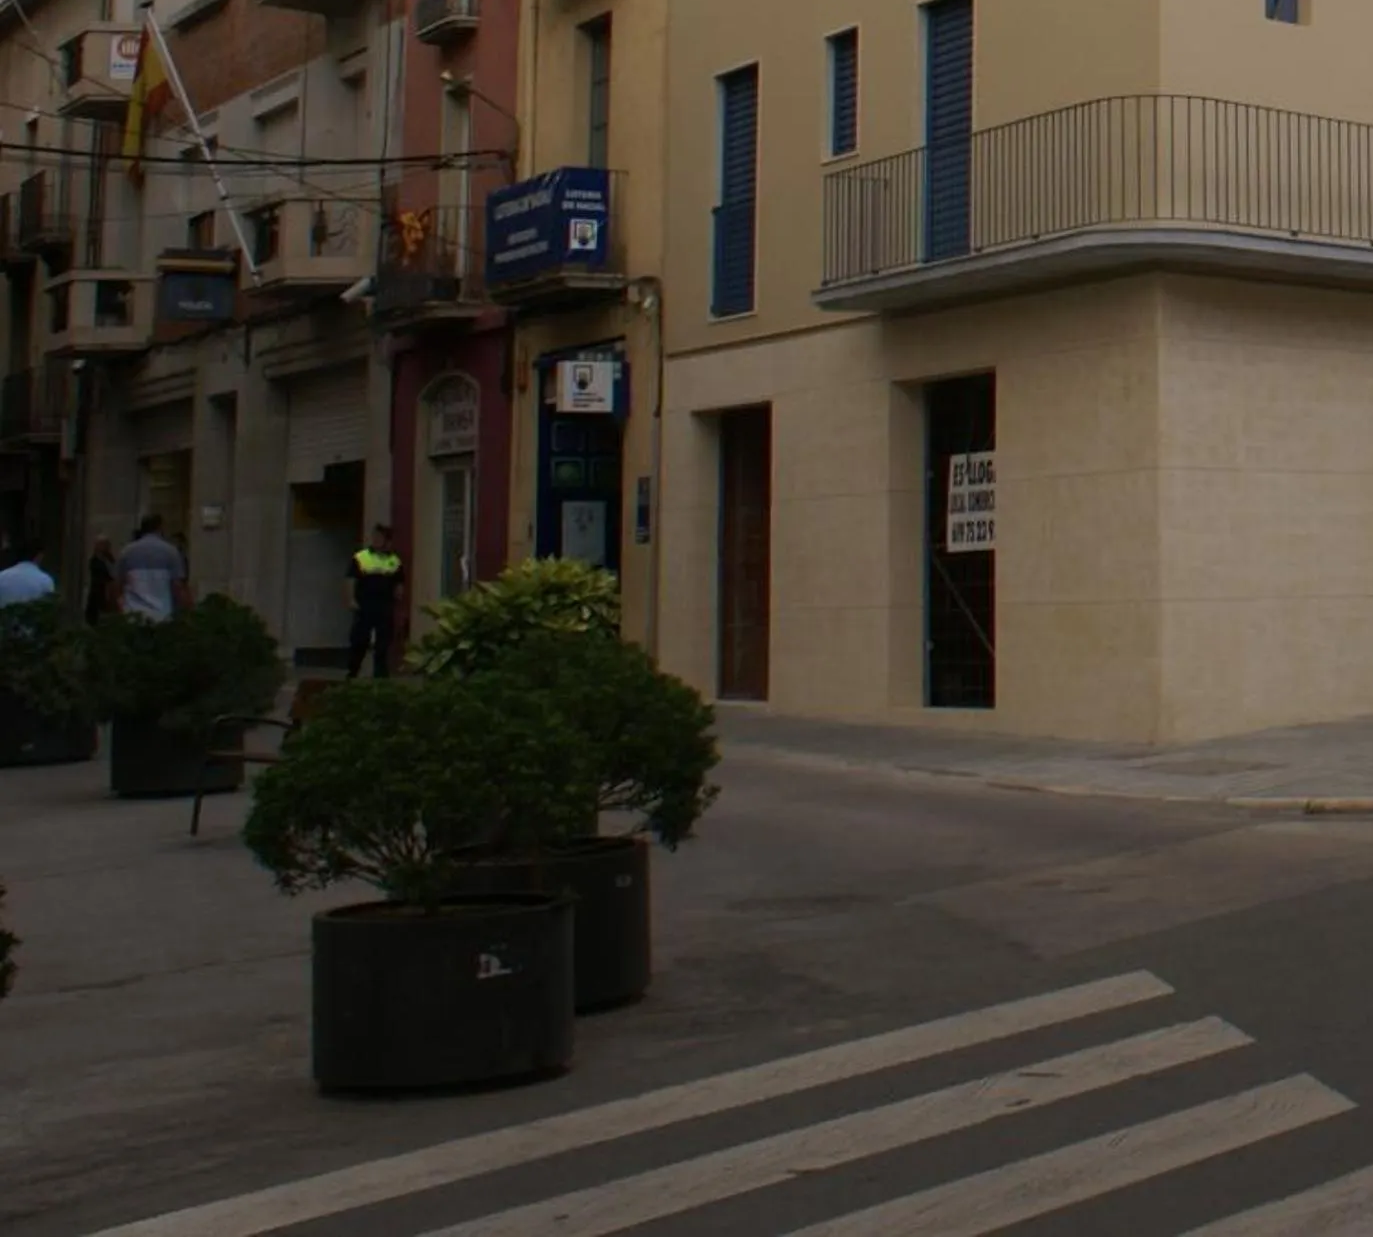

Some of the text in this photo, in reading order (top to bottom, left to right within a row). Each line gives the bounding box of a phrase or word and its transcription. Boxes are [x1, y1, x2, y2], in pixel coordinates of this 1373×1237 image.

[953, 459, 996, 487] ES LLOG
[988, 519, 996, 542] 9
